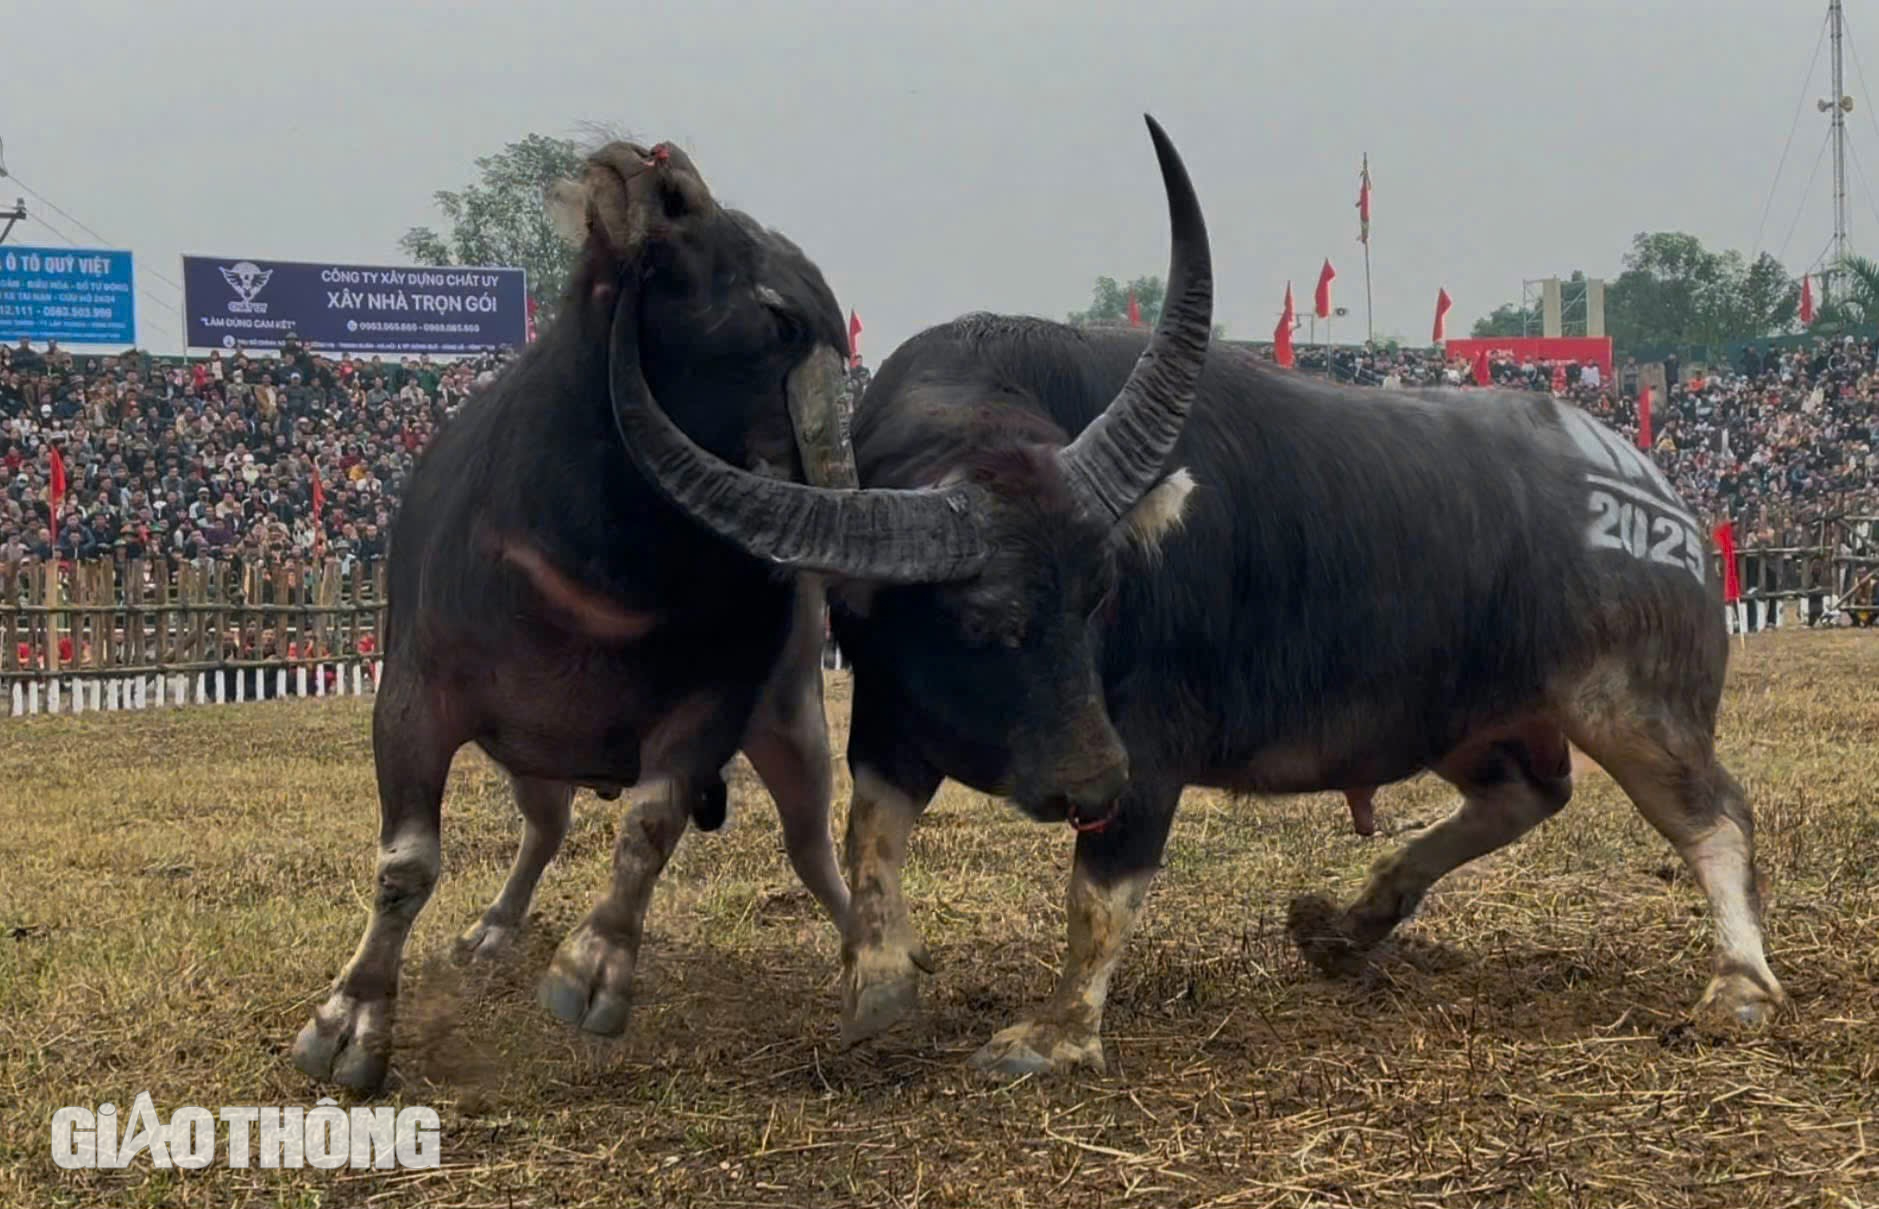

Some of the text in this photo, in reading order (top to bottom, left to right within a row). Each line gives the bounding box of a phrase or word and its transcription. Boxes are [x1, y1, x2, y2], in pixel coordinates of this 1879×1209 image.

[20, 252, 41, 273] TÔ
[78, 255, 111, 278] VIỆT
[321, 267, 360, 284] CÔNG
[361, 271, 379, 284] TY
[380, 269, 406, 286] XÂY
[407, 271, 444, 288] DỰNG
[481, 275, 499, 287] UY
[327, 287, 497, 315] XÂY NHÀ TRỌN GÓI
